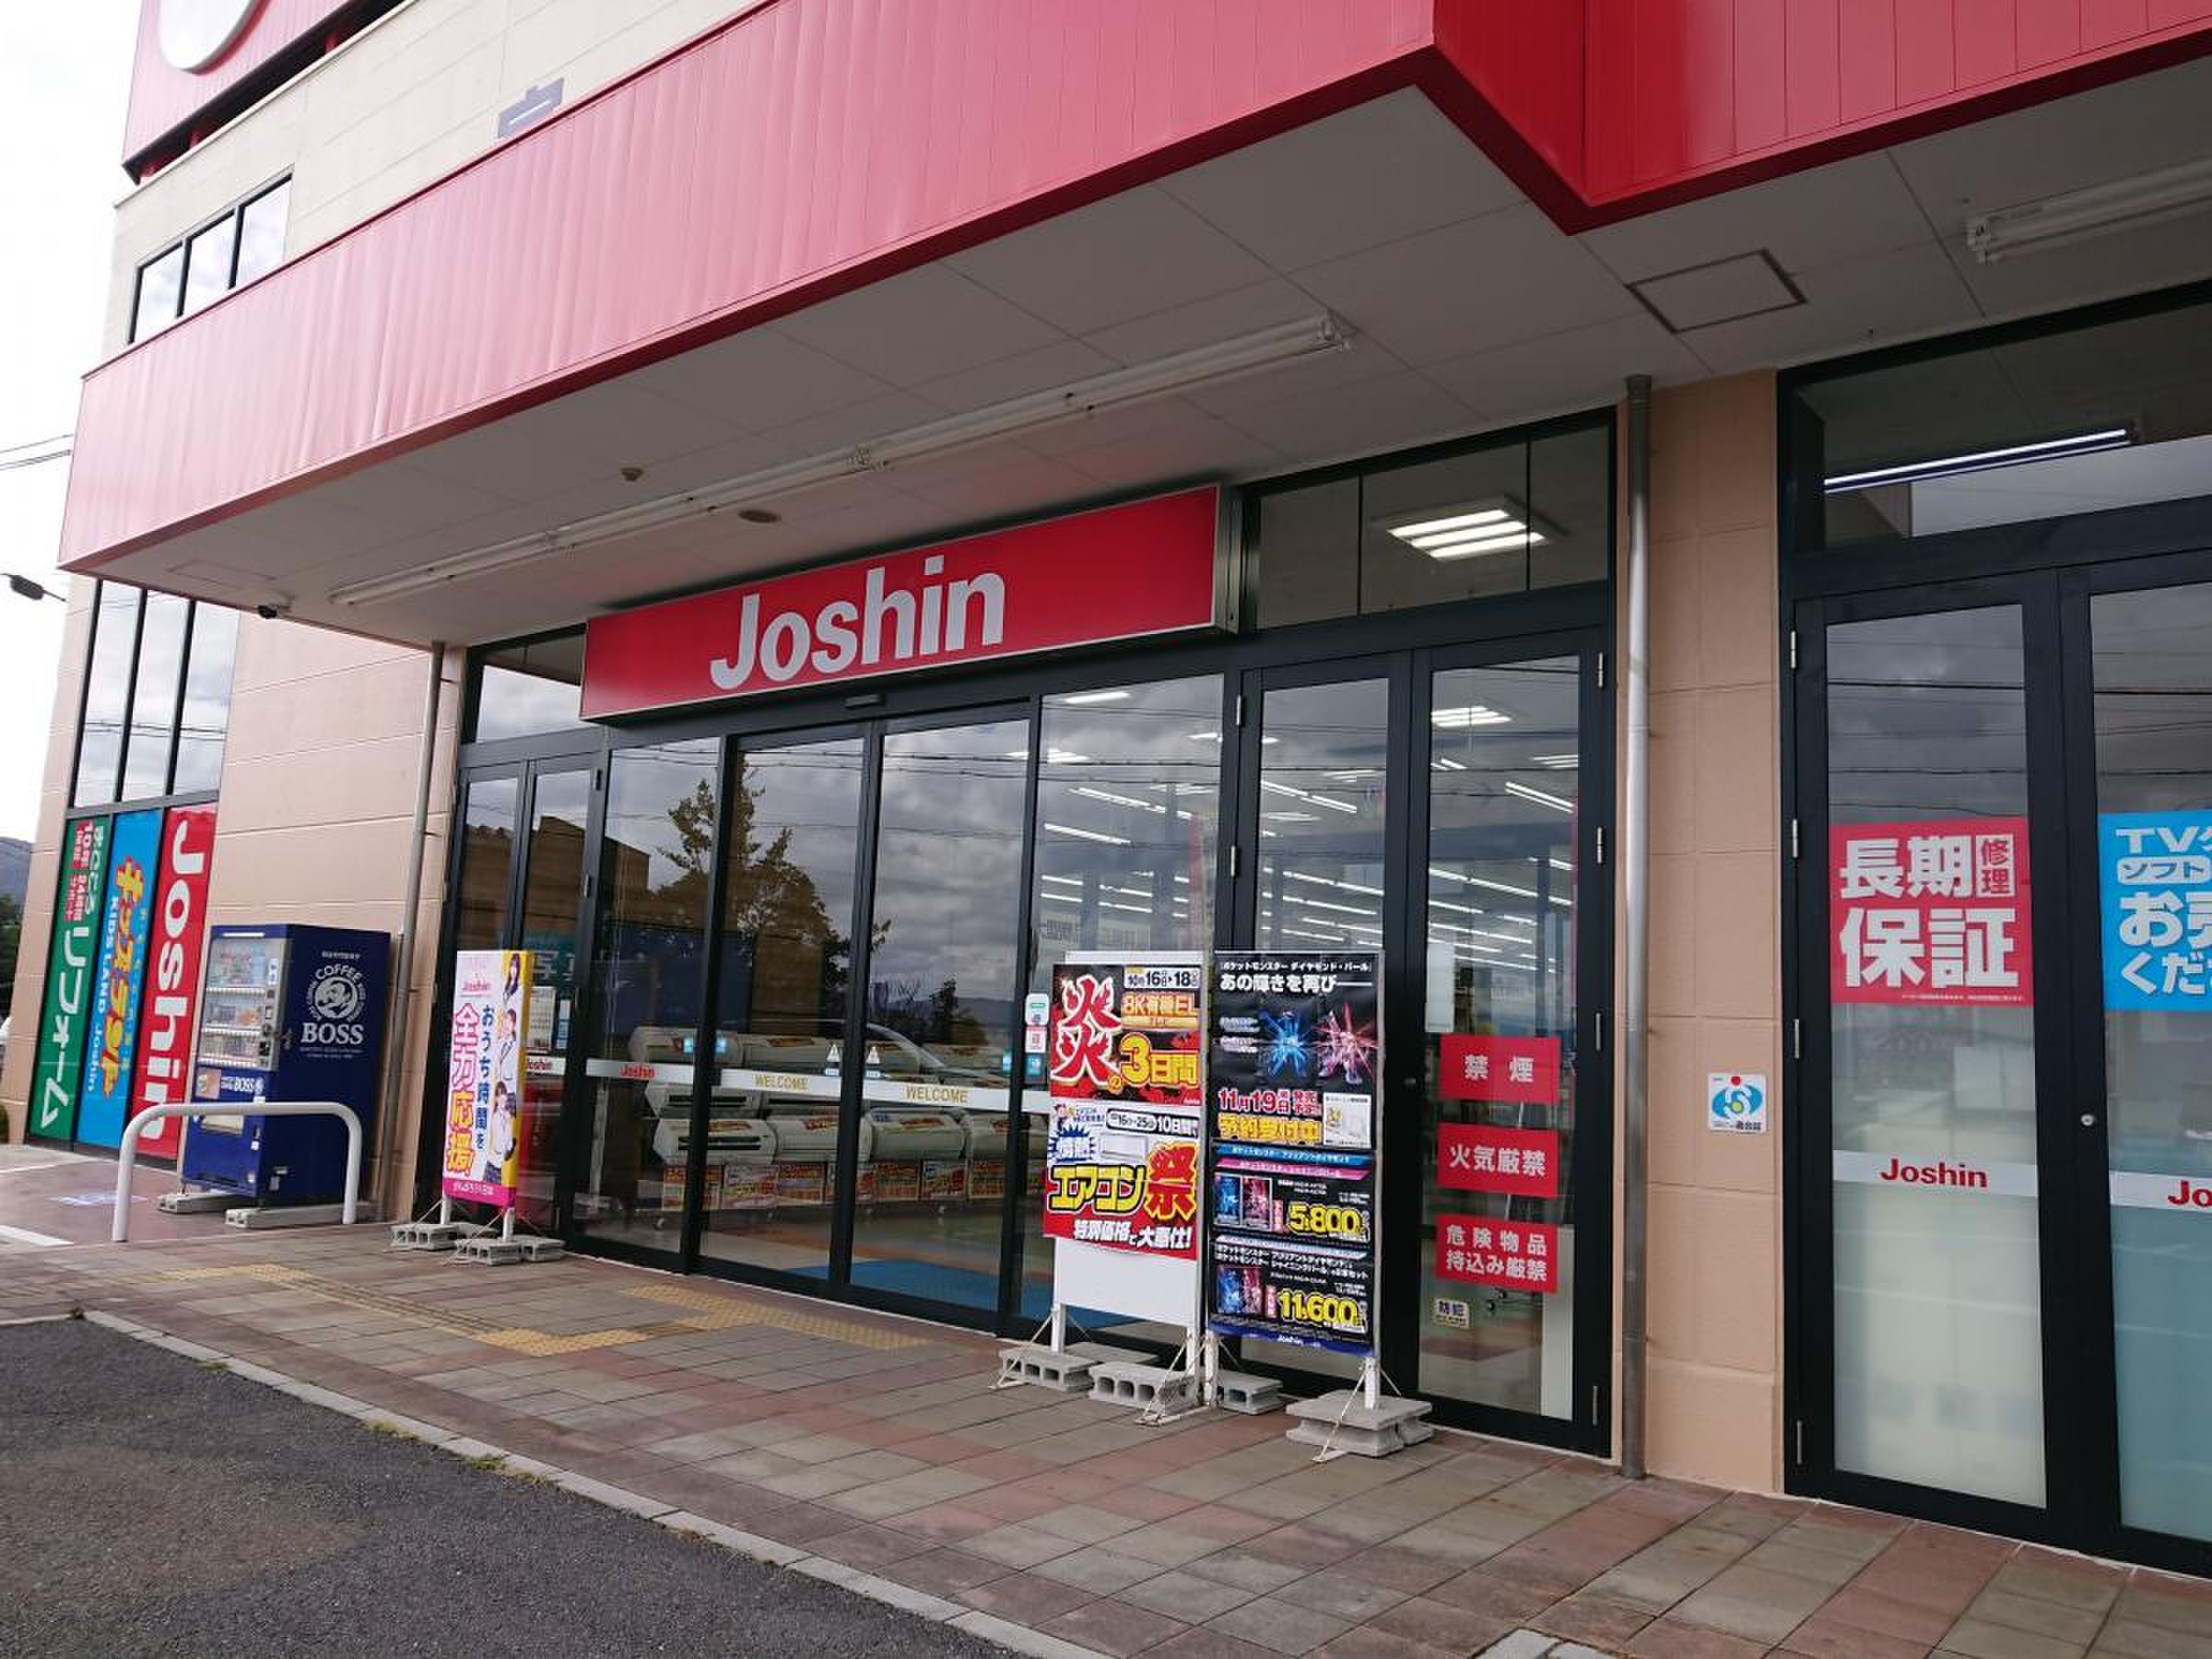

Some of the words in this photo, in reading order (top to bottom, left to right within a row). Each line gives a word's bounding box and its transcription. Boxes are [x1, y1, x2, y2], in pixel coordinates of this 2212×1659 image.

[710, 555, 1006, 690] Joshin
[1839, 834, 1972, 899] 長期
[1980, 837, 2011, 895] 修理
[2123, 861, 2206, 880] ソフト
[105, 896, 121, 954] KIDS
[1839, 907, 2019, 989] 保証
[97, 954, 113, 1015] LAND
[100, 854, 146, 1098] キッズランド
[140, 820, 206, 1140] Joshin
[314, 963, 363, 983] COFFEE
[41, 925, 90, 1129] リフォーム
[300, 1022, 364, 1044] BOSS
[88, 1020, 104, 1092] Joshin
[475, 1005, 495, 1150] おうち時間を
[1464, 1053, 1535, 1083] 禁煙
[754, 1074, 810, 1092] WELCOME
[905, 1085, 970, 1104] WELCOME
[1449, 1144, 1546, 1177] 火気厳禁
[1879, 1158, 1988, 1188] Joshin
[2168, 1180, 2212, 1207] Jo
[1446, 1224, 1547, 1256] 危険物品
[1445, 1250, 1547, 1282] 持込み厳禁
